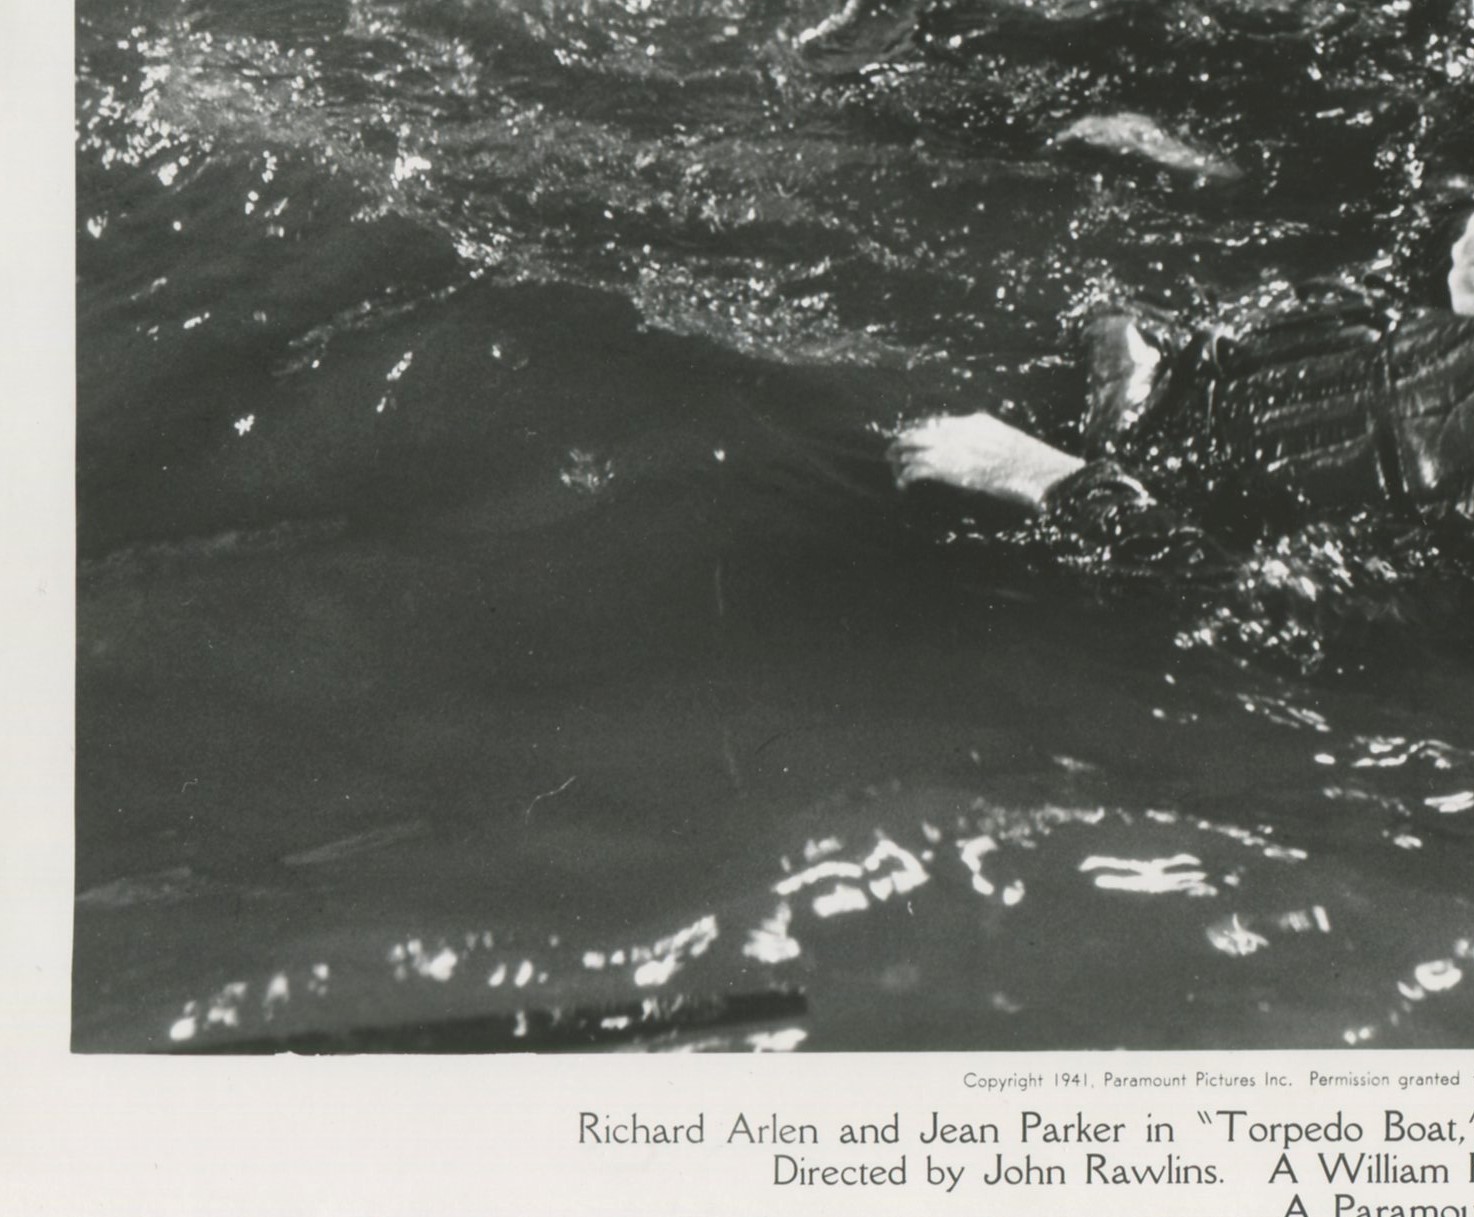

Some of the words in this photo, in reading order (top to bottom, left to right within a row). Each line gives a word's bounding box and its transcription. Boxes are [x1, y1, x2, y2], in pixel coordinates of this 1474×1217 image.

[963, 1072, 1043, 1092] Copyright
[1104, 1071, 1187, 1088] Paramount
[1195, 1071, 1256, 1087] Pictures
[1265, 1071, 1293, 1087] Inc.
[1309, 1070, 1389, 1087] Permission
[1398, 1071, 1460, 1090] granted
[578, 1111, 705, 1144] Richard
[726, 1112, 819, 1145] Arlen
[839, 1111, 900, 1145] and
[919, 1111, 1000, 1145] Jean
[1021, 1110, 1126, 1144] Parker
[1146, 1112, 1175, 1143] in
[773, 1154, 907, 1186] Directed
[926, 1154, 965, 1193] by
[983, 1153, 1066, 1186] John
[1085, 1152, 1224, 1185] Rawlins.
[1267, 1152, 1299, 1184] A
[1317, 1152, 1450, 1185] William
[1284, 1193, 1309, 1217] A
